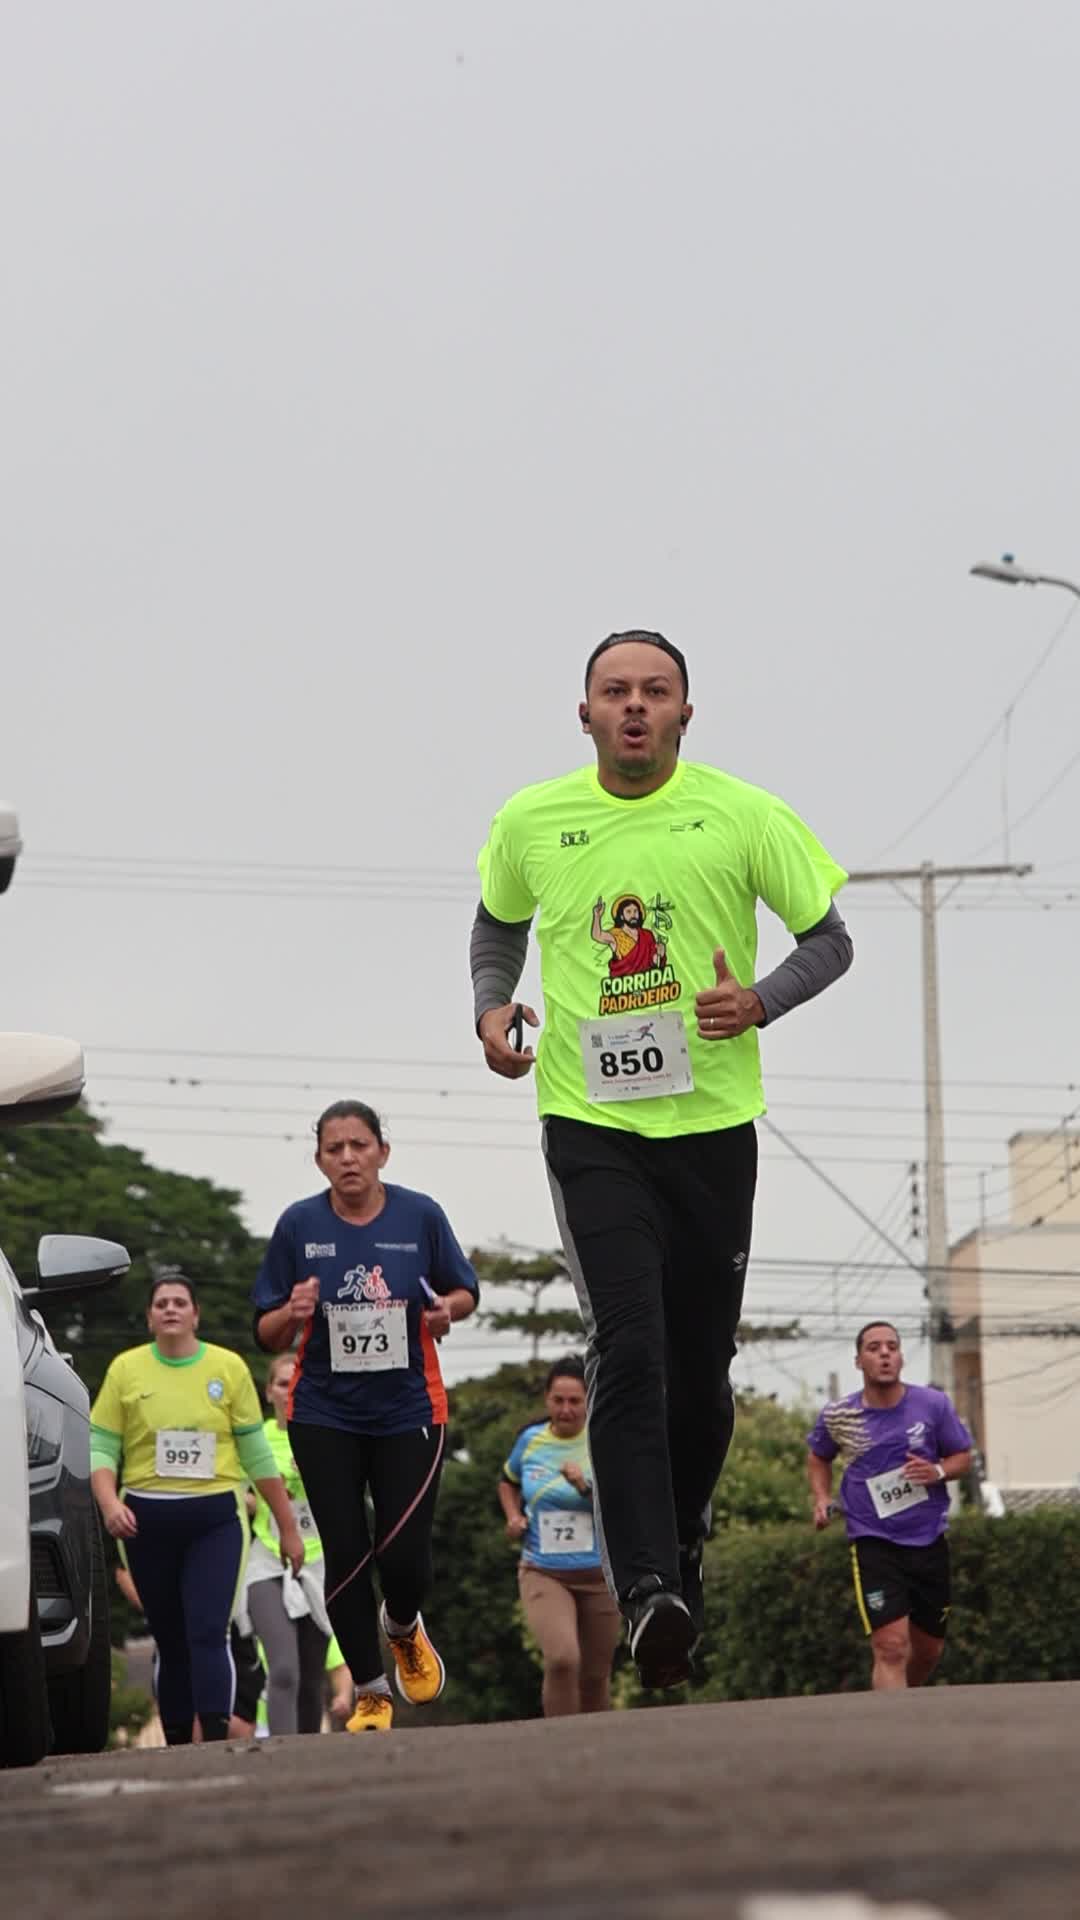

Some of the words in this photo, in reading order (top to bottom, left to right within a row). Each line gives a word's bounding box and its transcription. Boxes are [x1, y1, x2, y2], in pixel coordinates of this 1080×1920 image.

[602, 967, 675, 996] CORRIDA
[600, 983, 679, 1015] PADROEIRO
[600, 1047, 663, 1077] 850
[342, 1333, 389, 1354] 973
[165, 1449, 202, 1464] 997
[881, 1482, 912, 1504] 994
[553, 1527, 574, 1541] 72
